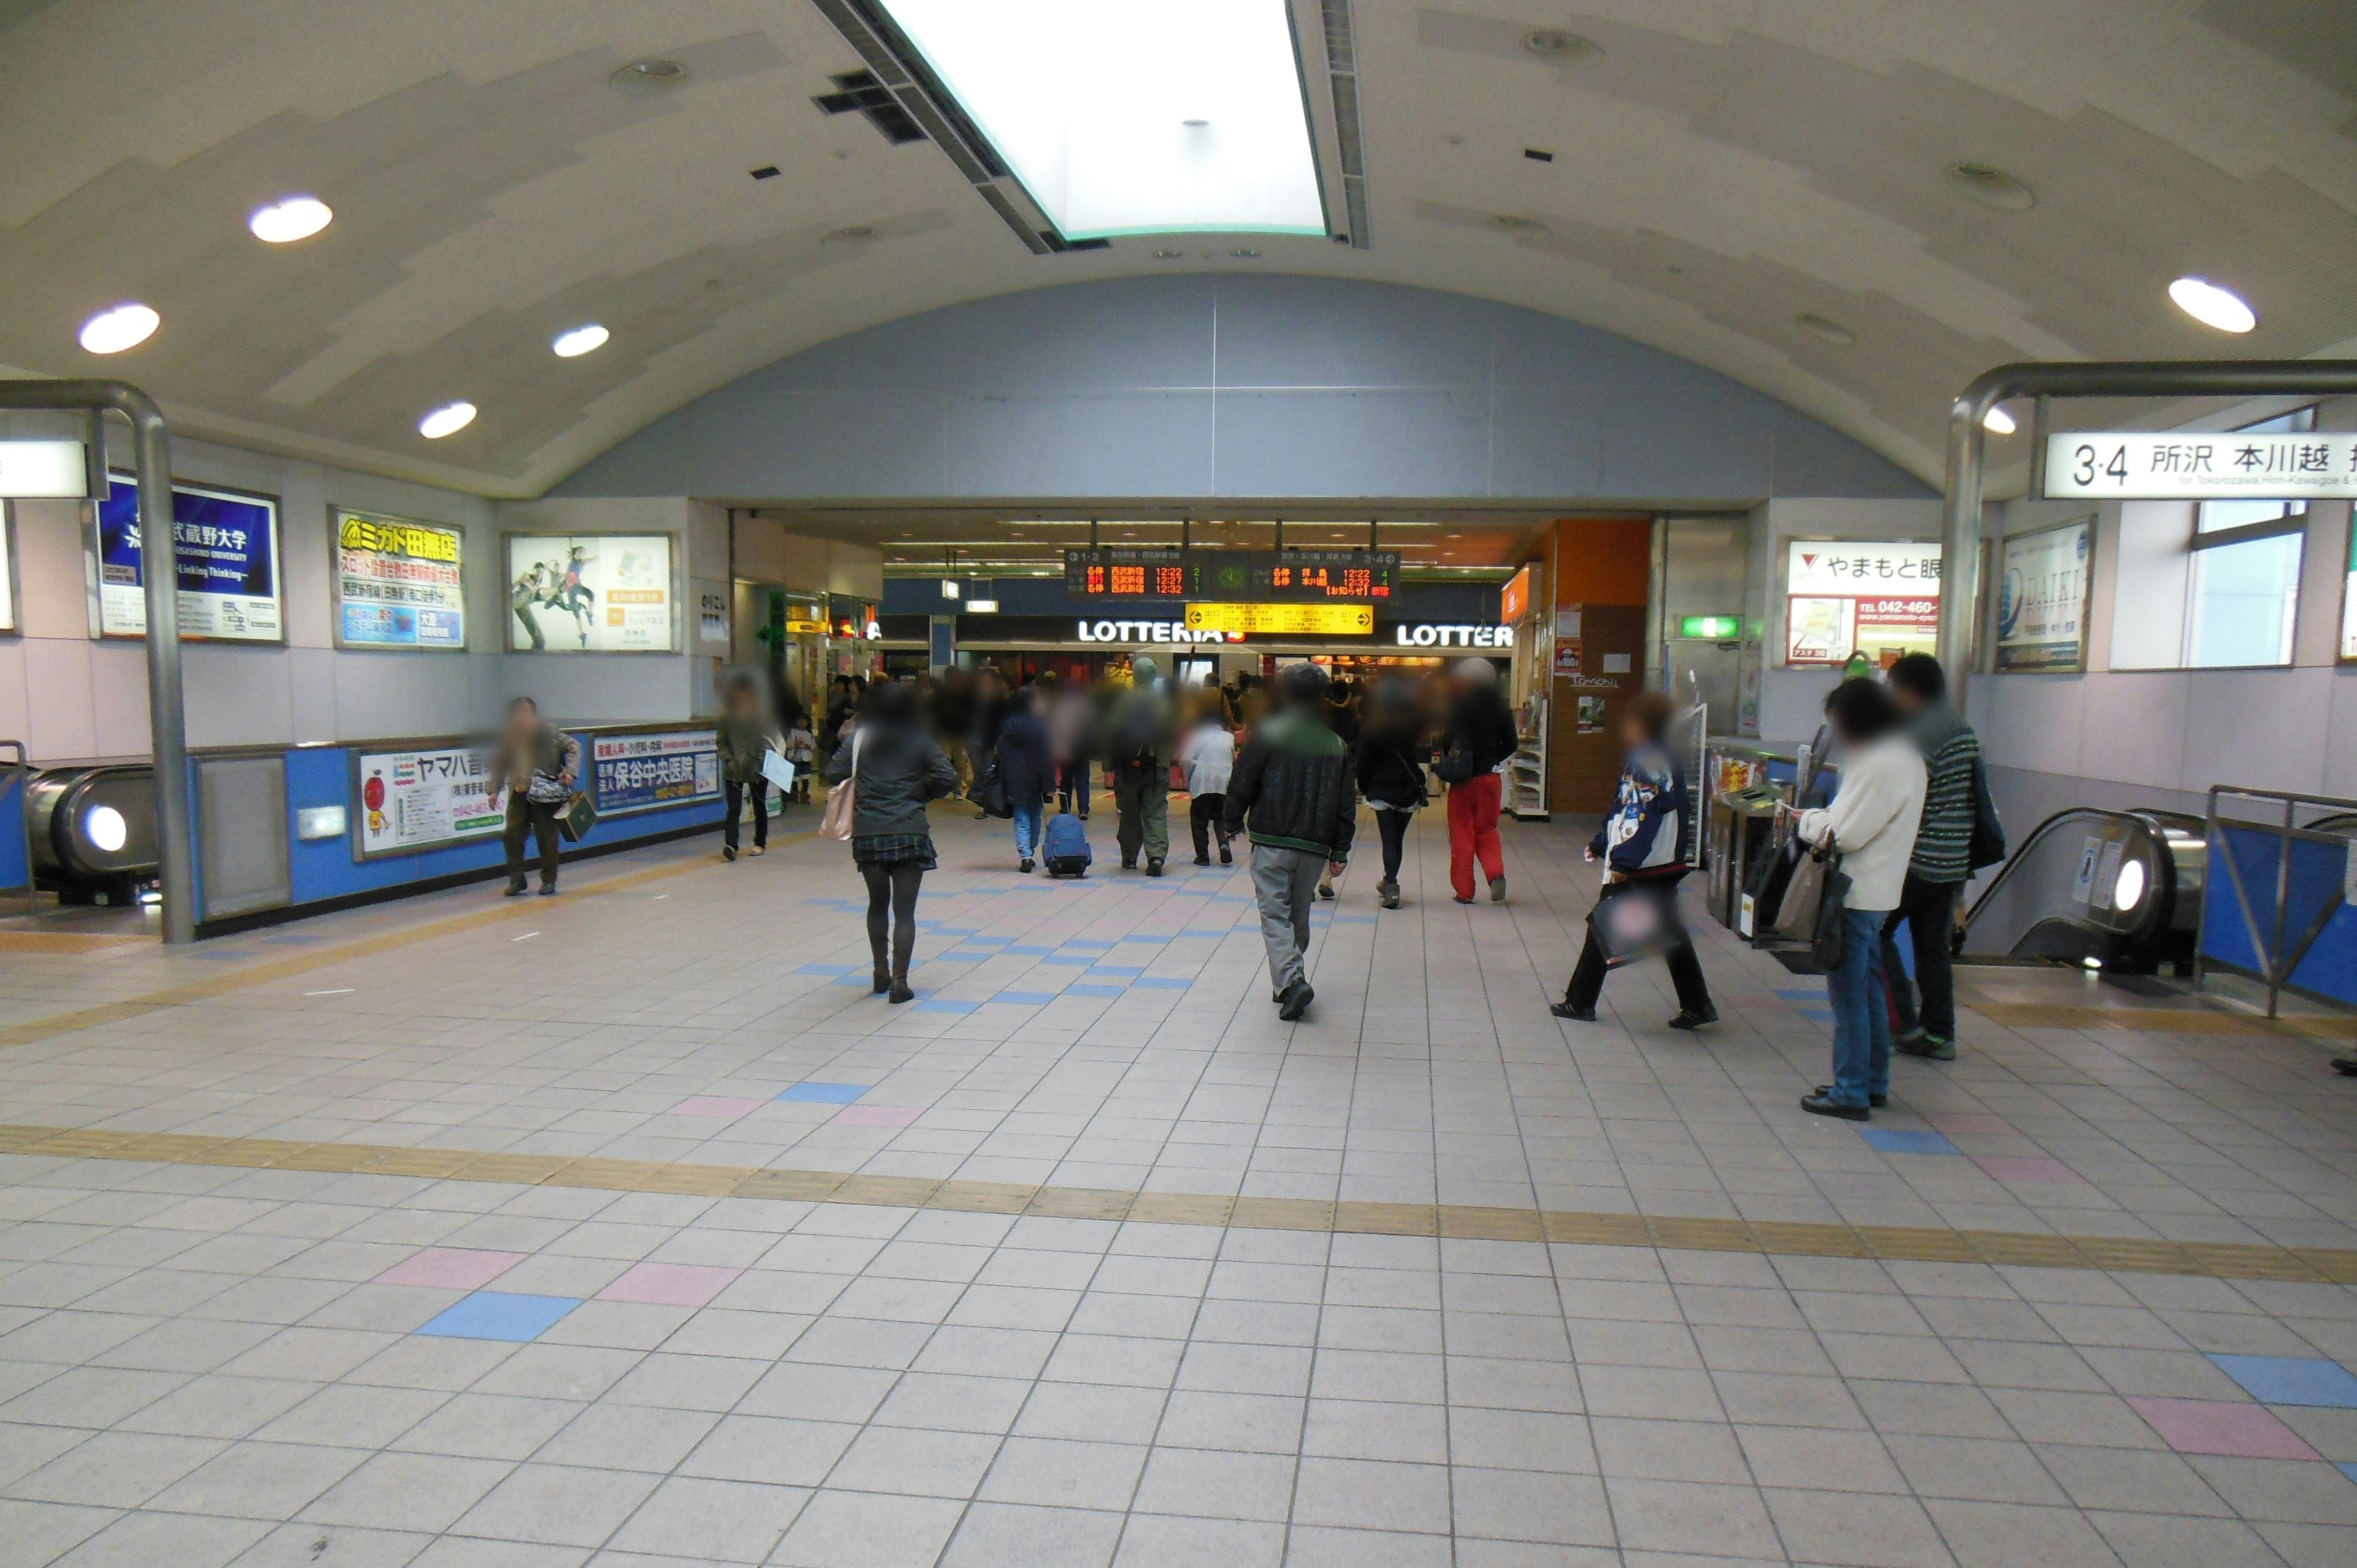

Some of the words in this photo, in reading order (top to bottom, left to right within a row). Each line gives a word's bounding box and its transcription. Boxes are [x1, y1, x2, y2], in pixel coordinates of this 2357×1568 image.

[2150, 444, 2213, 473] 所沢
[2233, 443, 2330, 472] 本川越
[172, 521, 247, 551] 武蔵野大学
[360, 520, 457, 564] ミカド田無店
[210, 550, 247, 562] UNIVERSITY
[1087, 566, 1104, 575] 各停
[1111, 566, 1145, 576] 西武新宿
[1156, 567, 1182, 576] 12:22
[1273, 568, 1291, 577] 各停
[1344, 569, 1370, 578] 12:22
[1827, 557, 1943, 578] やまもと眼
[1087, 575, 1104, 585] 急行
[1111, 575, 1145, 585] 西武新宿
[1156, 576, 1182, 585] 12:27
[1273, 577, 1291, 586] 各停
[1302, 577, 1328, 587] 本川越
[1344, 578, 1370, 587] 12:32
[1087, 584, 1104, 593] 各停
[1111, 584, 1145, 593] 西武新宿
[1156, 585, 1182, 594] 12:32
[1371, 586, 1390, 596] 新宿
[611, 592, 659, 601] 北口徒歩1分
[1859, 603, 1877, 613] TEL
[1878, 600, 1939, 613] 042-460-
[1079, 621, 1224, 642] LOTTERIA
[416, 752, 495, 782] ヤマハ音
[614, 756, 693, 791] 保谷中央医院
